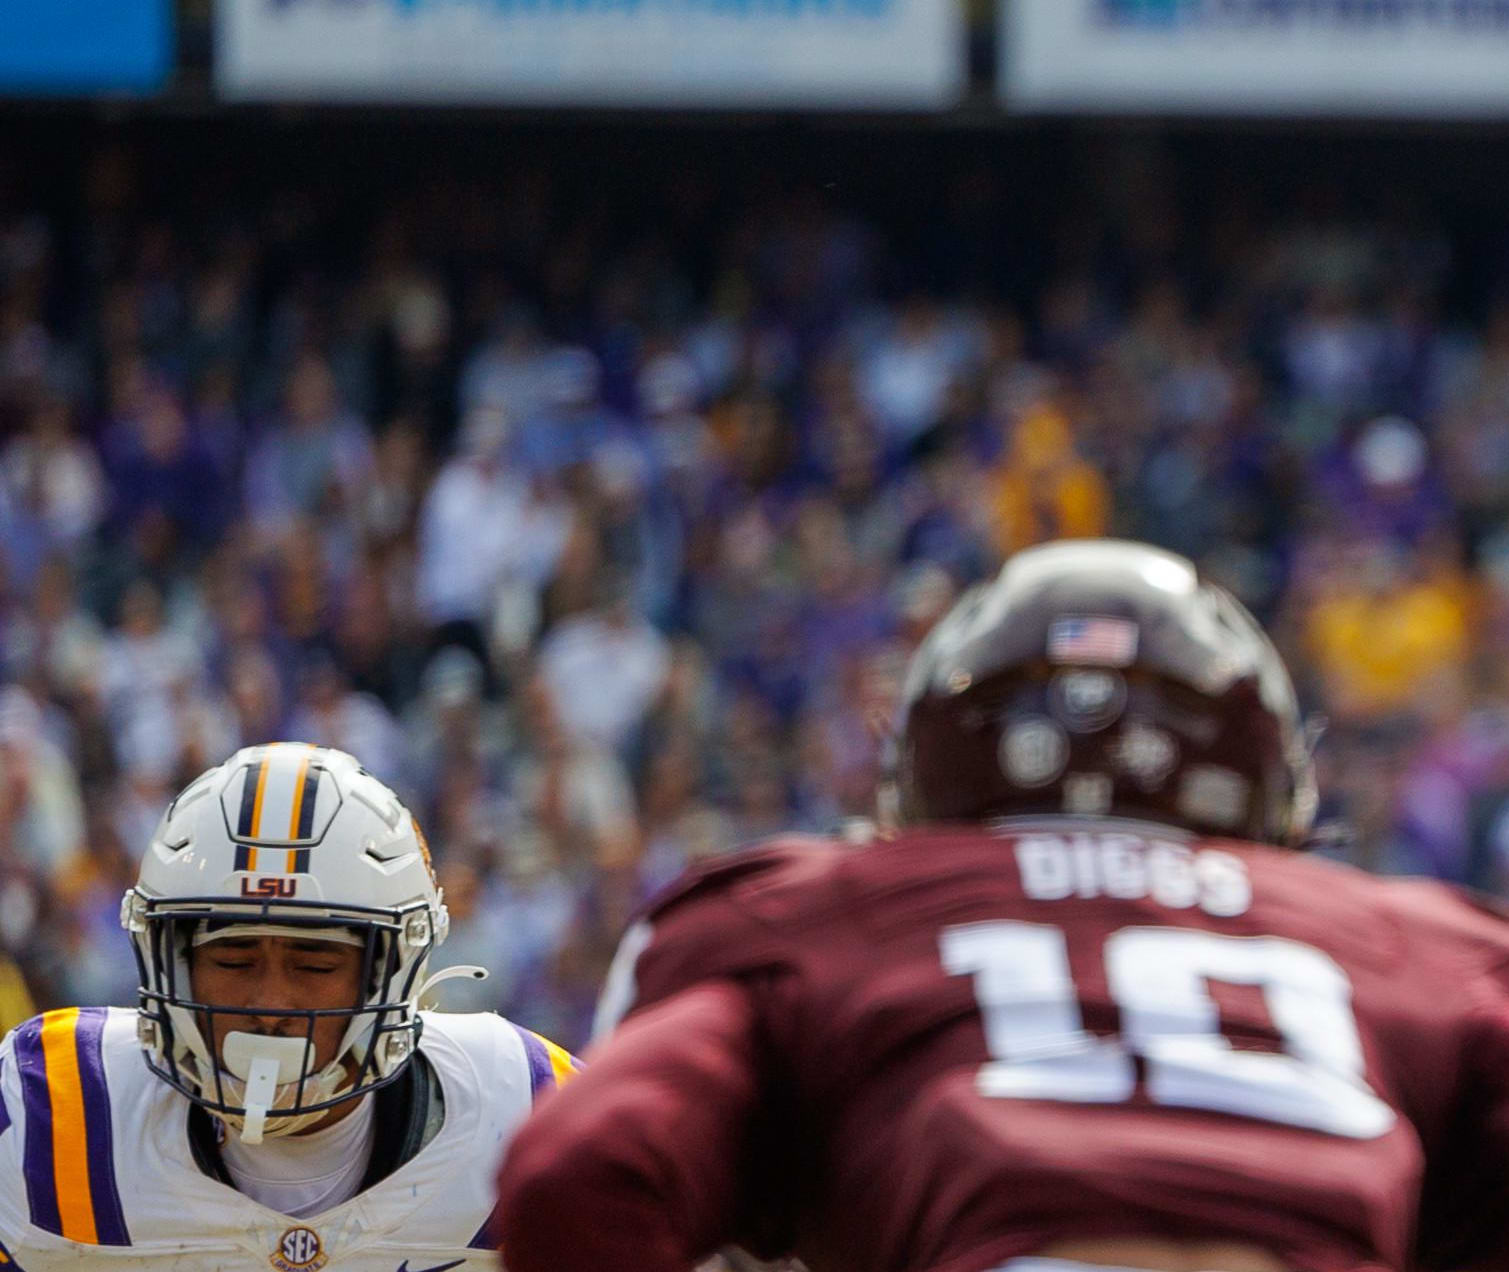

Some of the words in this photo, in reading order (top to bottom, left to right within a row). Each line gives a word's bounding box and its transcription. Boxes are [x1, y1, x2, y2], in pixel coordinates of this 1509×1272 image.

[240, 876, 297, 898] LSU
[1012, 832, 1252, 918] DIGGS
[938, 919, 1398, 1140] 10
[282, 1229, 318, 1265] SEC
